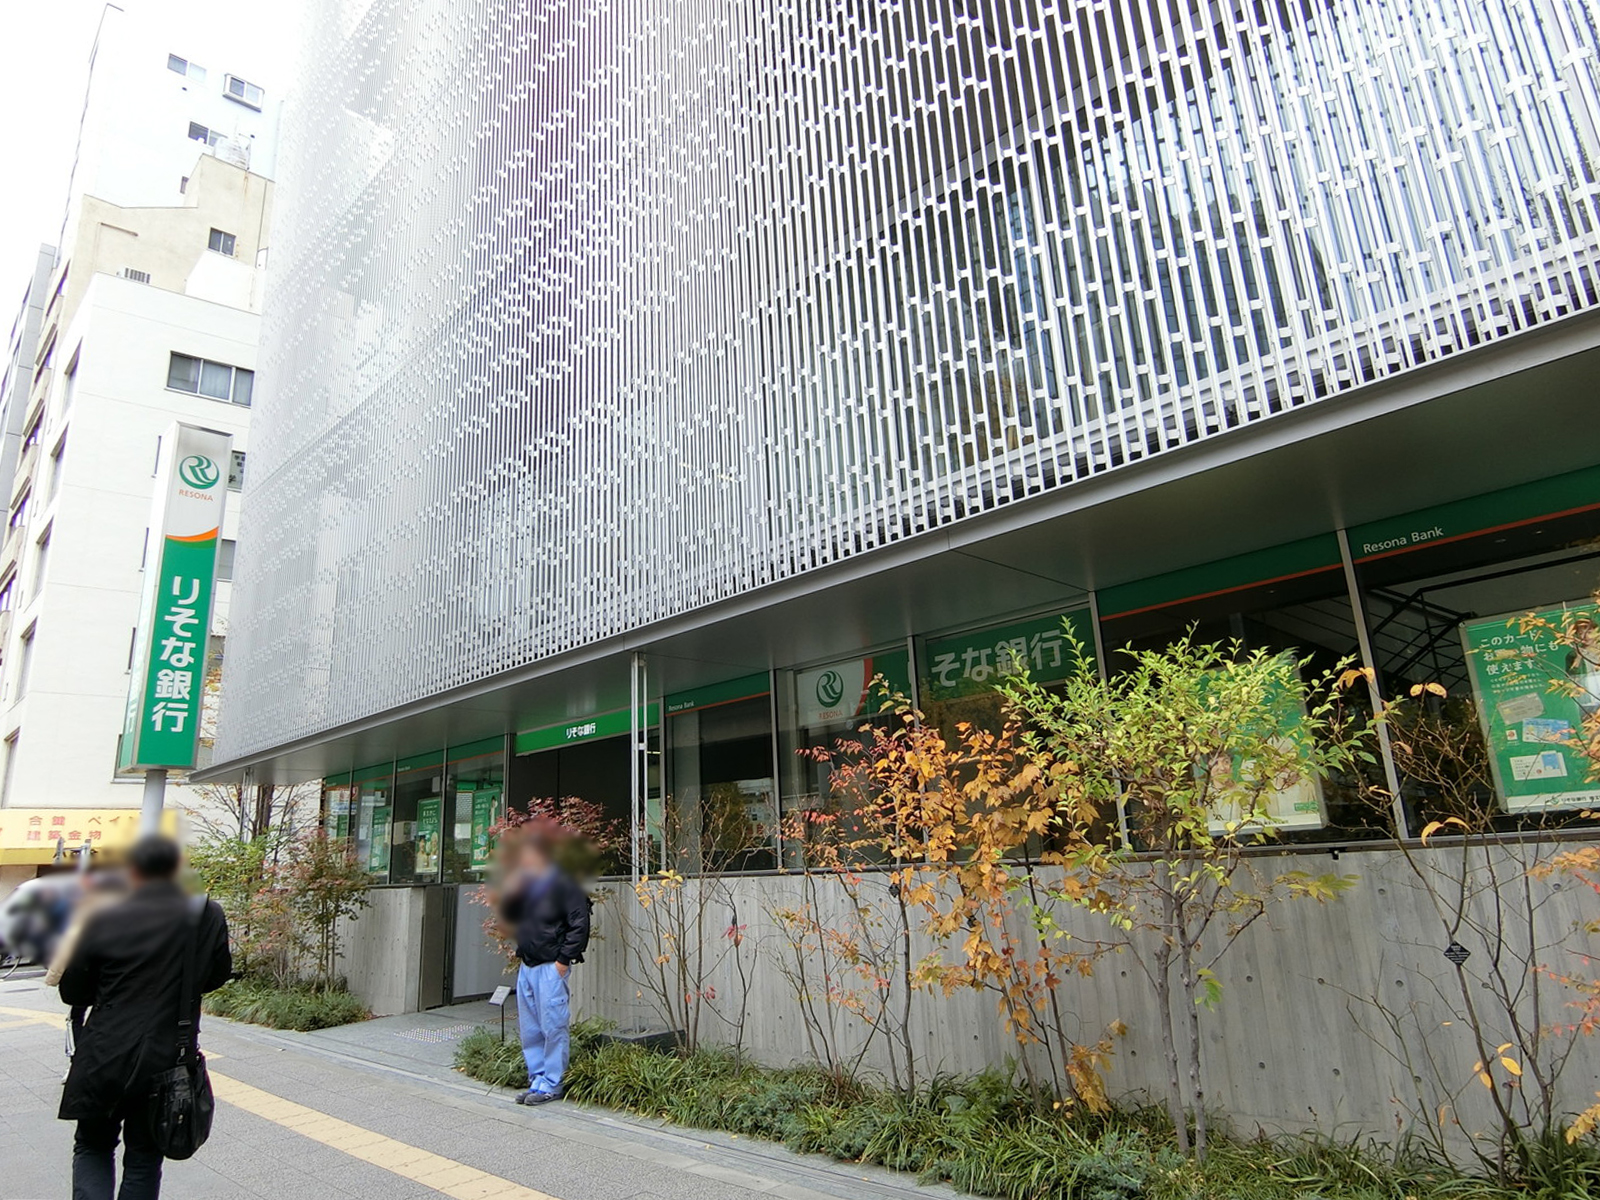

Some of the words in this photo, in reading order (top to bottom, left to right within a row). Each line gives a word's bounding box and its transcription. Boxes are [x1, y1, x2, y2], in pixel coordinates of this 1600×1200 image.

[178, 489, 214, 502] RESONA
[1363, 538, 1407, 554] Resona
[1411, 526, 1444, 542] Bank
[151, 575, 200, 732] りそな銀行
[908, 629, 1063, 687] そな銀行
[1483, 641, 1559, 661] お物にも
[1486, 659, 1535, 675] 使えます
[819, 710, 843, 720] RESONA
[566, 722, 596, 739] りそな銀行
